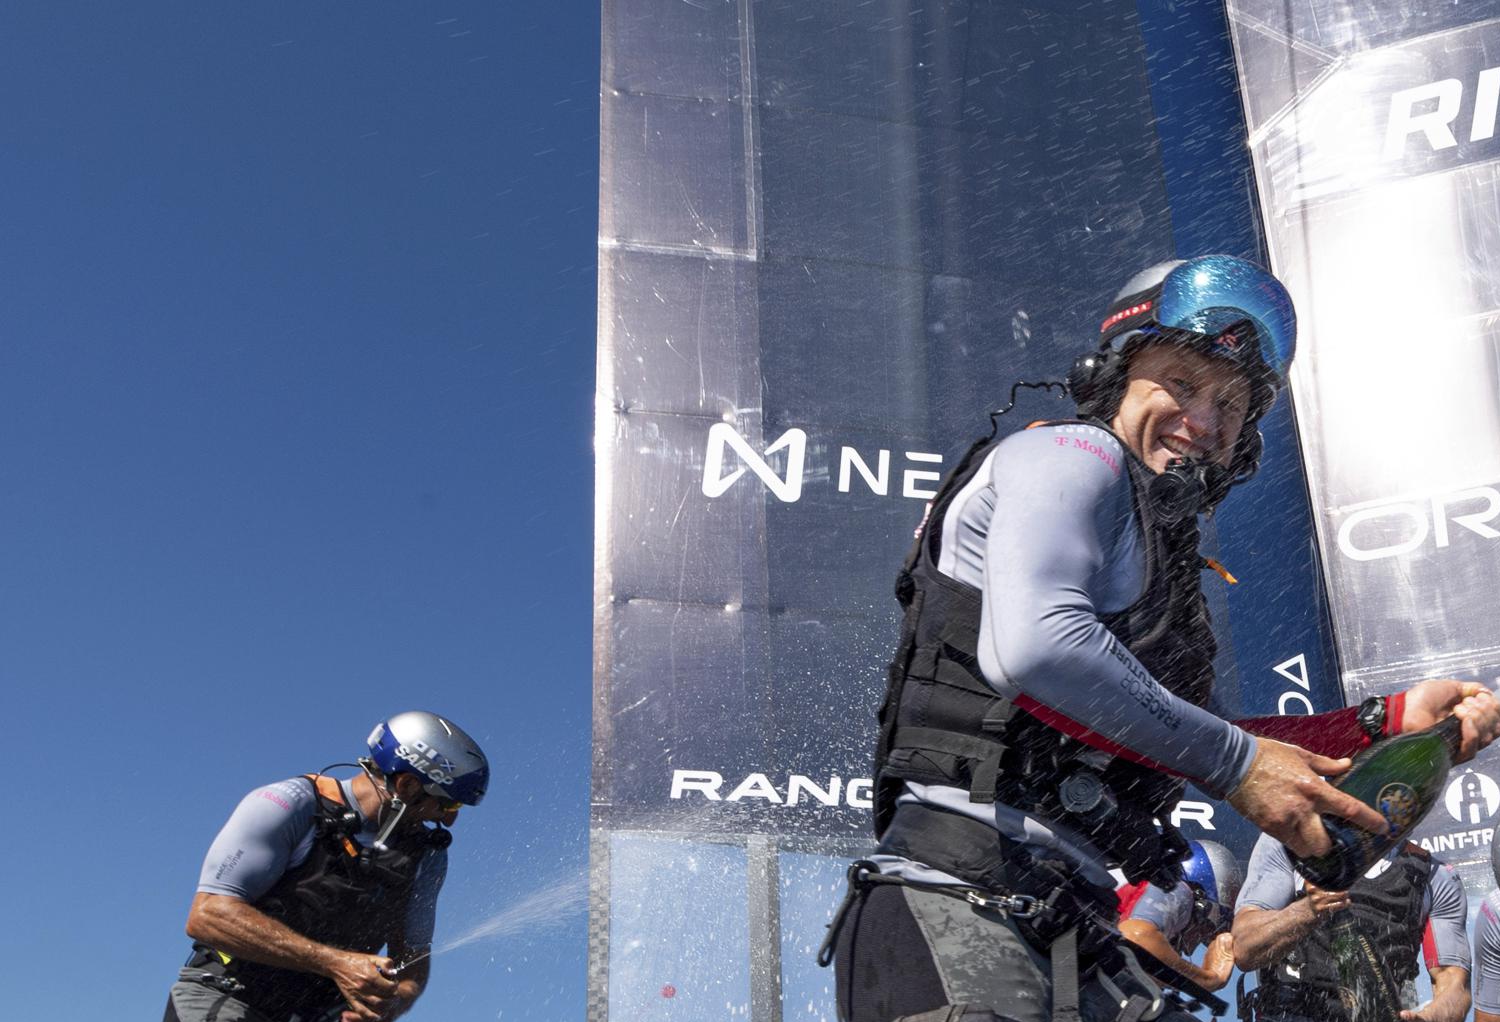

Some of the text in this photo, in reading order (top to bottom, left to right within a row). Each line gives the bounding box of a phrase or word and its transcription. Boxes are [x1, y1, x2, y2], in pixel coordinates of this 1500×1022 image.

[838, 446, 943, 500] NE
[395, 744, 455, 785] SAILGP
[670, 769, 874, 809] RANG
